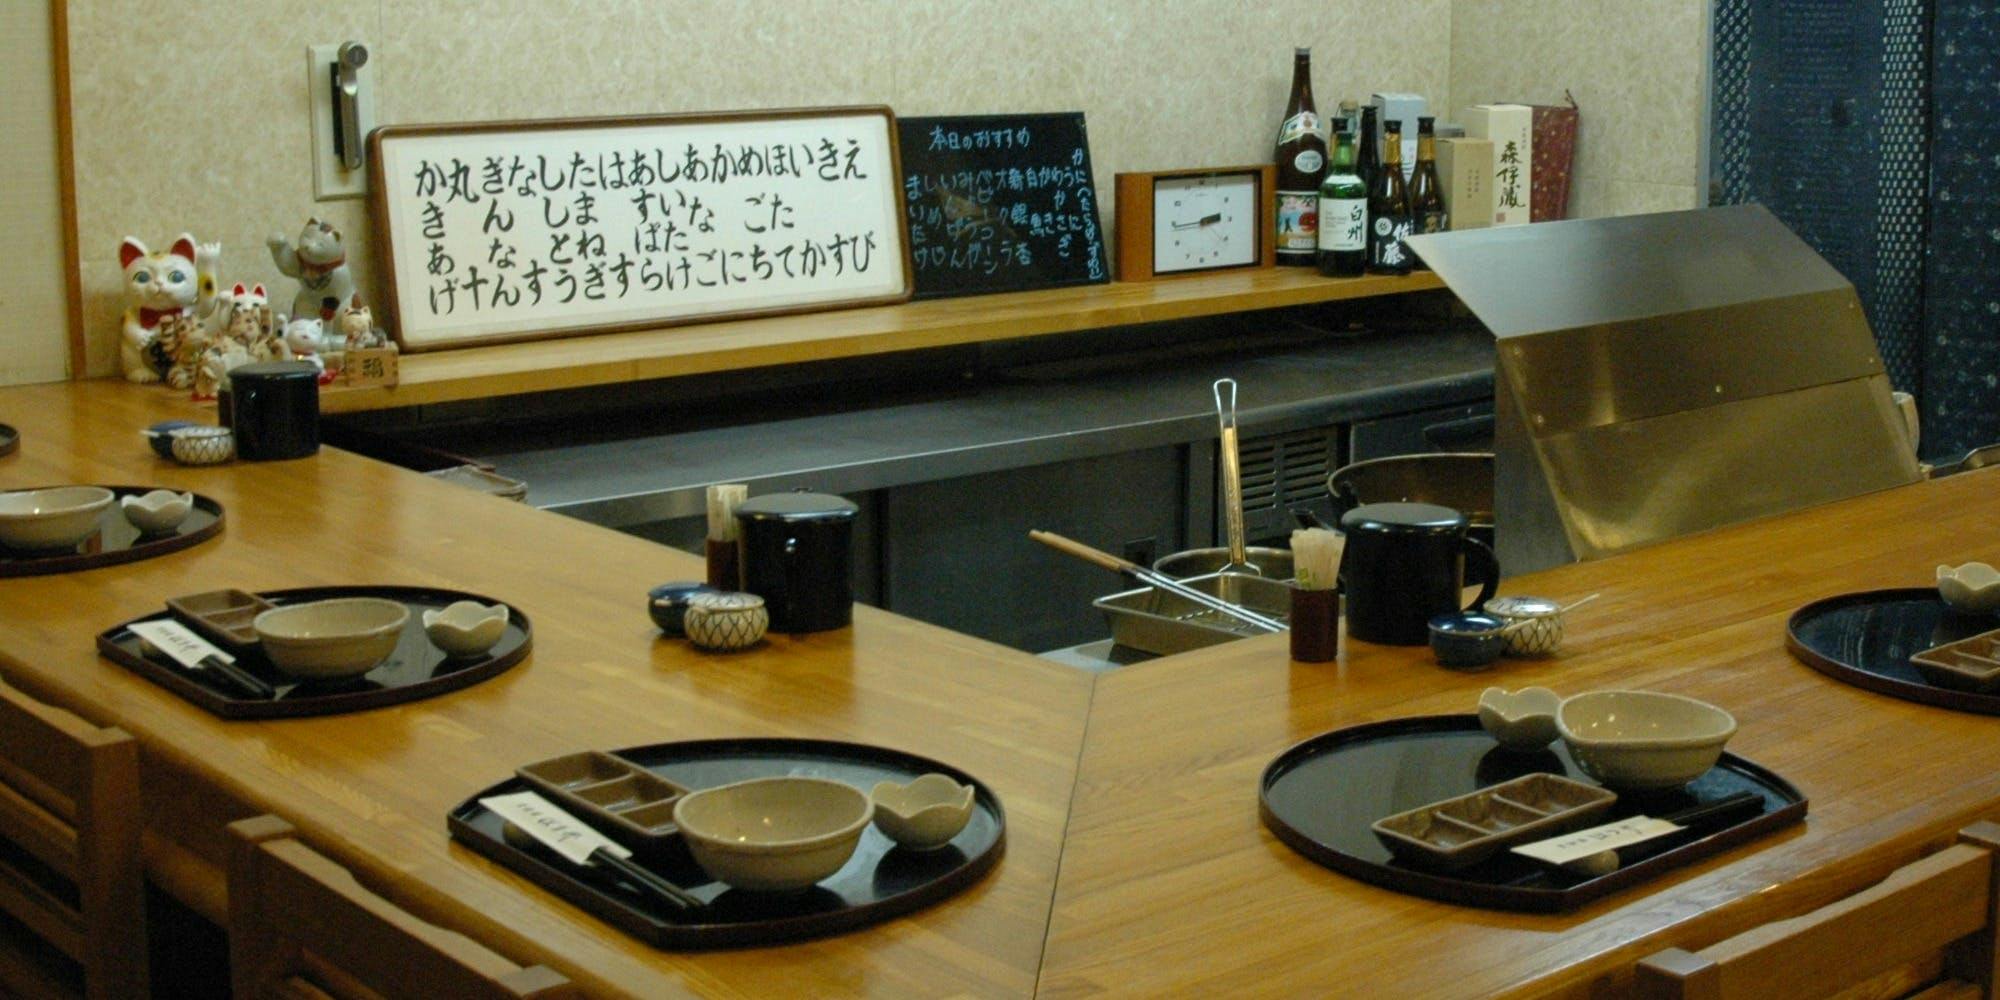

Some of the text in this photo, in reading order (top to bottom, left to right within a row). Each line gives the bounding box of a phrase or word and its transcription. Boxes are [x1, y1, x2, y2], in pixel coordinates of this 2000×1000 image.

[818, 138, 849, 276] きす
[844, 139, 876, 273] えび
[928, 124, 1030, 150] 本日のおすすめ
[1064, 166, 1084, 231] うに
[1496, 140, 1526, 208] 森伊蔵
[415, 160, 458, 315] かきあげ
[448, 158, 488, 311] 丸十
[483, 157, 520, 308] ぎんなん
[508, 155, 548, 306] なす
[537, 155, 577, 304] ししとう
[569, 151, 606, 300] たまねぎ
[599, 151, 634, 298] はす
[656, 148, 691, 291] しいたけ
[682, 143, 717, 287] あなご
[712, 143, 747, 285] かに
[738, 146, 773, 280] めごち
[765, 144, 794, 278] ほたて
[789, 144, 826, 278] いか
[905, 174, 928, 270] まいたけ
[1347, 204, 1364, 244] 白州
